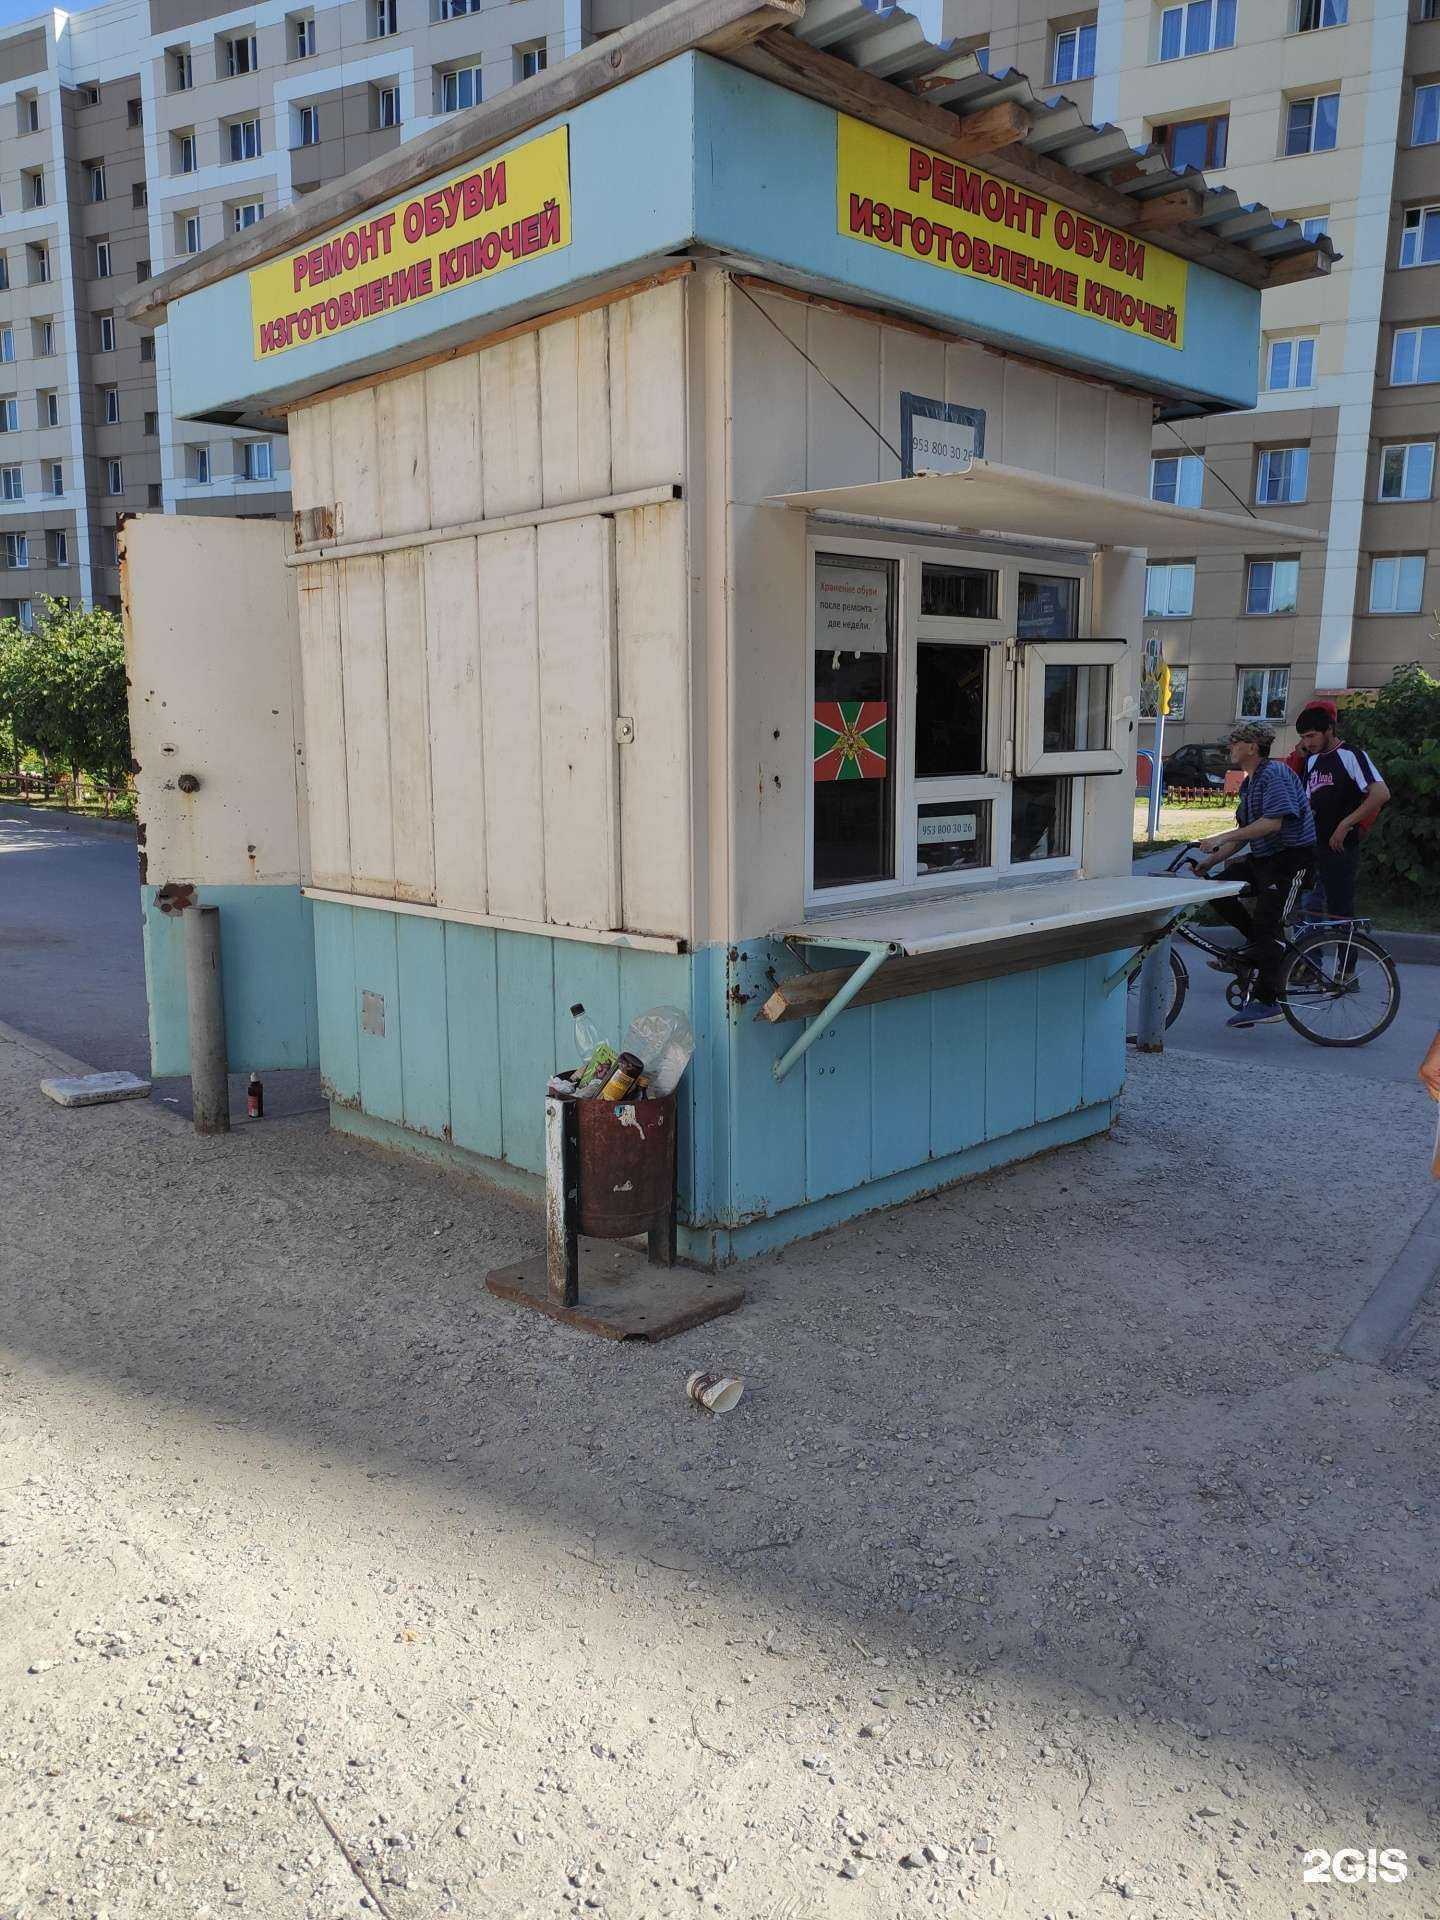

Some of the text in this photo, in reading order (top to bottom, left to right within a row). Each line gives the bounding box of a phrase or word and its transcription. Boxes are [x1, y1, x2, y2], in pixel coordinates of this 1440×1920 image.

[293, 161, 507, 293] РЕМОНТ ОБУВИ
[909, 147, 1146, 281] РЕМОНТ ОБУВИ
[260, 198, 560, 353] ИЗГОТОВЛЕНИЕ КЛЮЧЕЙ
[849, 192, 1177, 343] ИЗГОТОВЛЕНИЕ КЛЮЧЕЙ
[912, 437, 929, 453] 953
[932, 442, 948, 457] 800
[950, 446, 961, 460] 30
[820, 601, 841, 610] после
[843, 603, 873, 613] ремонта
[827, 620, 841, 628] две
[922, 823, 973, 835] 953 800 30 26
